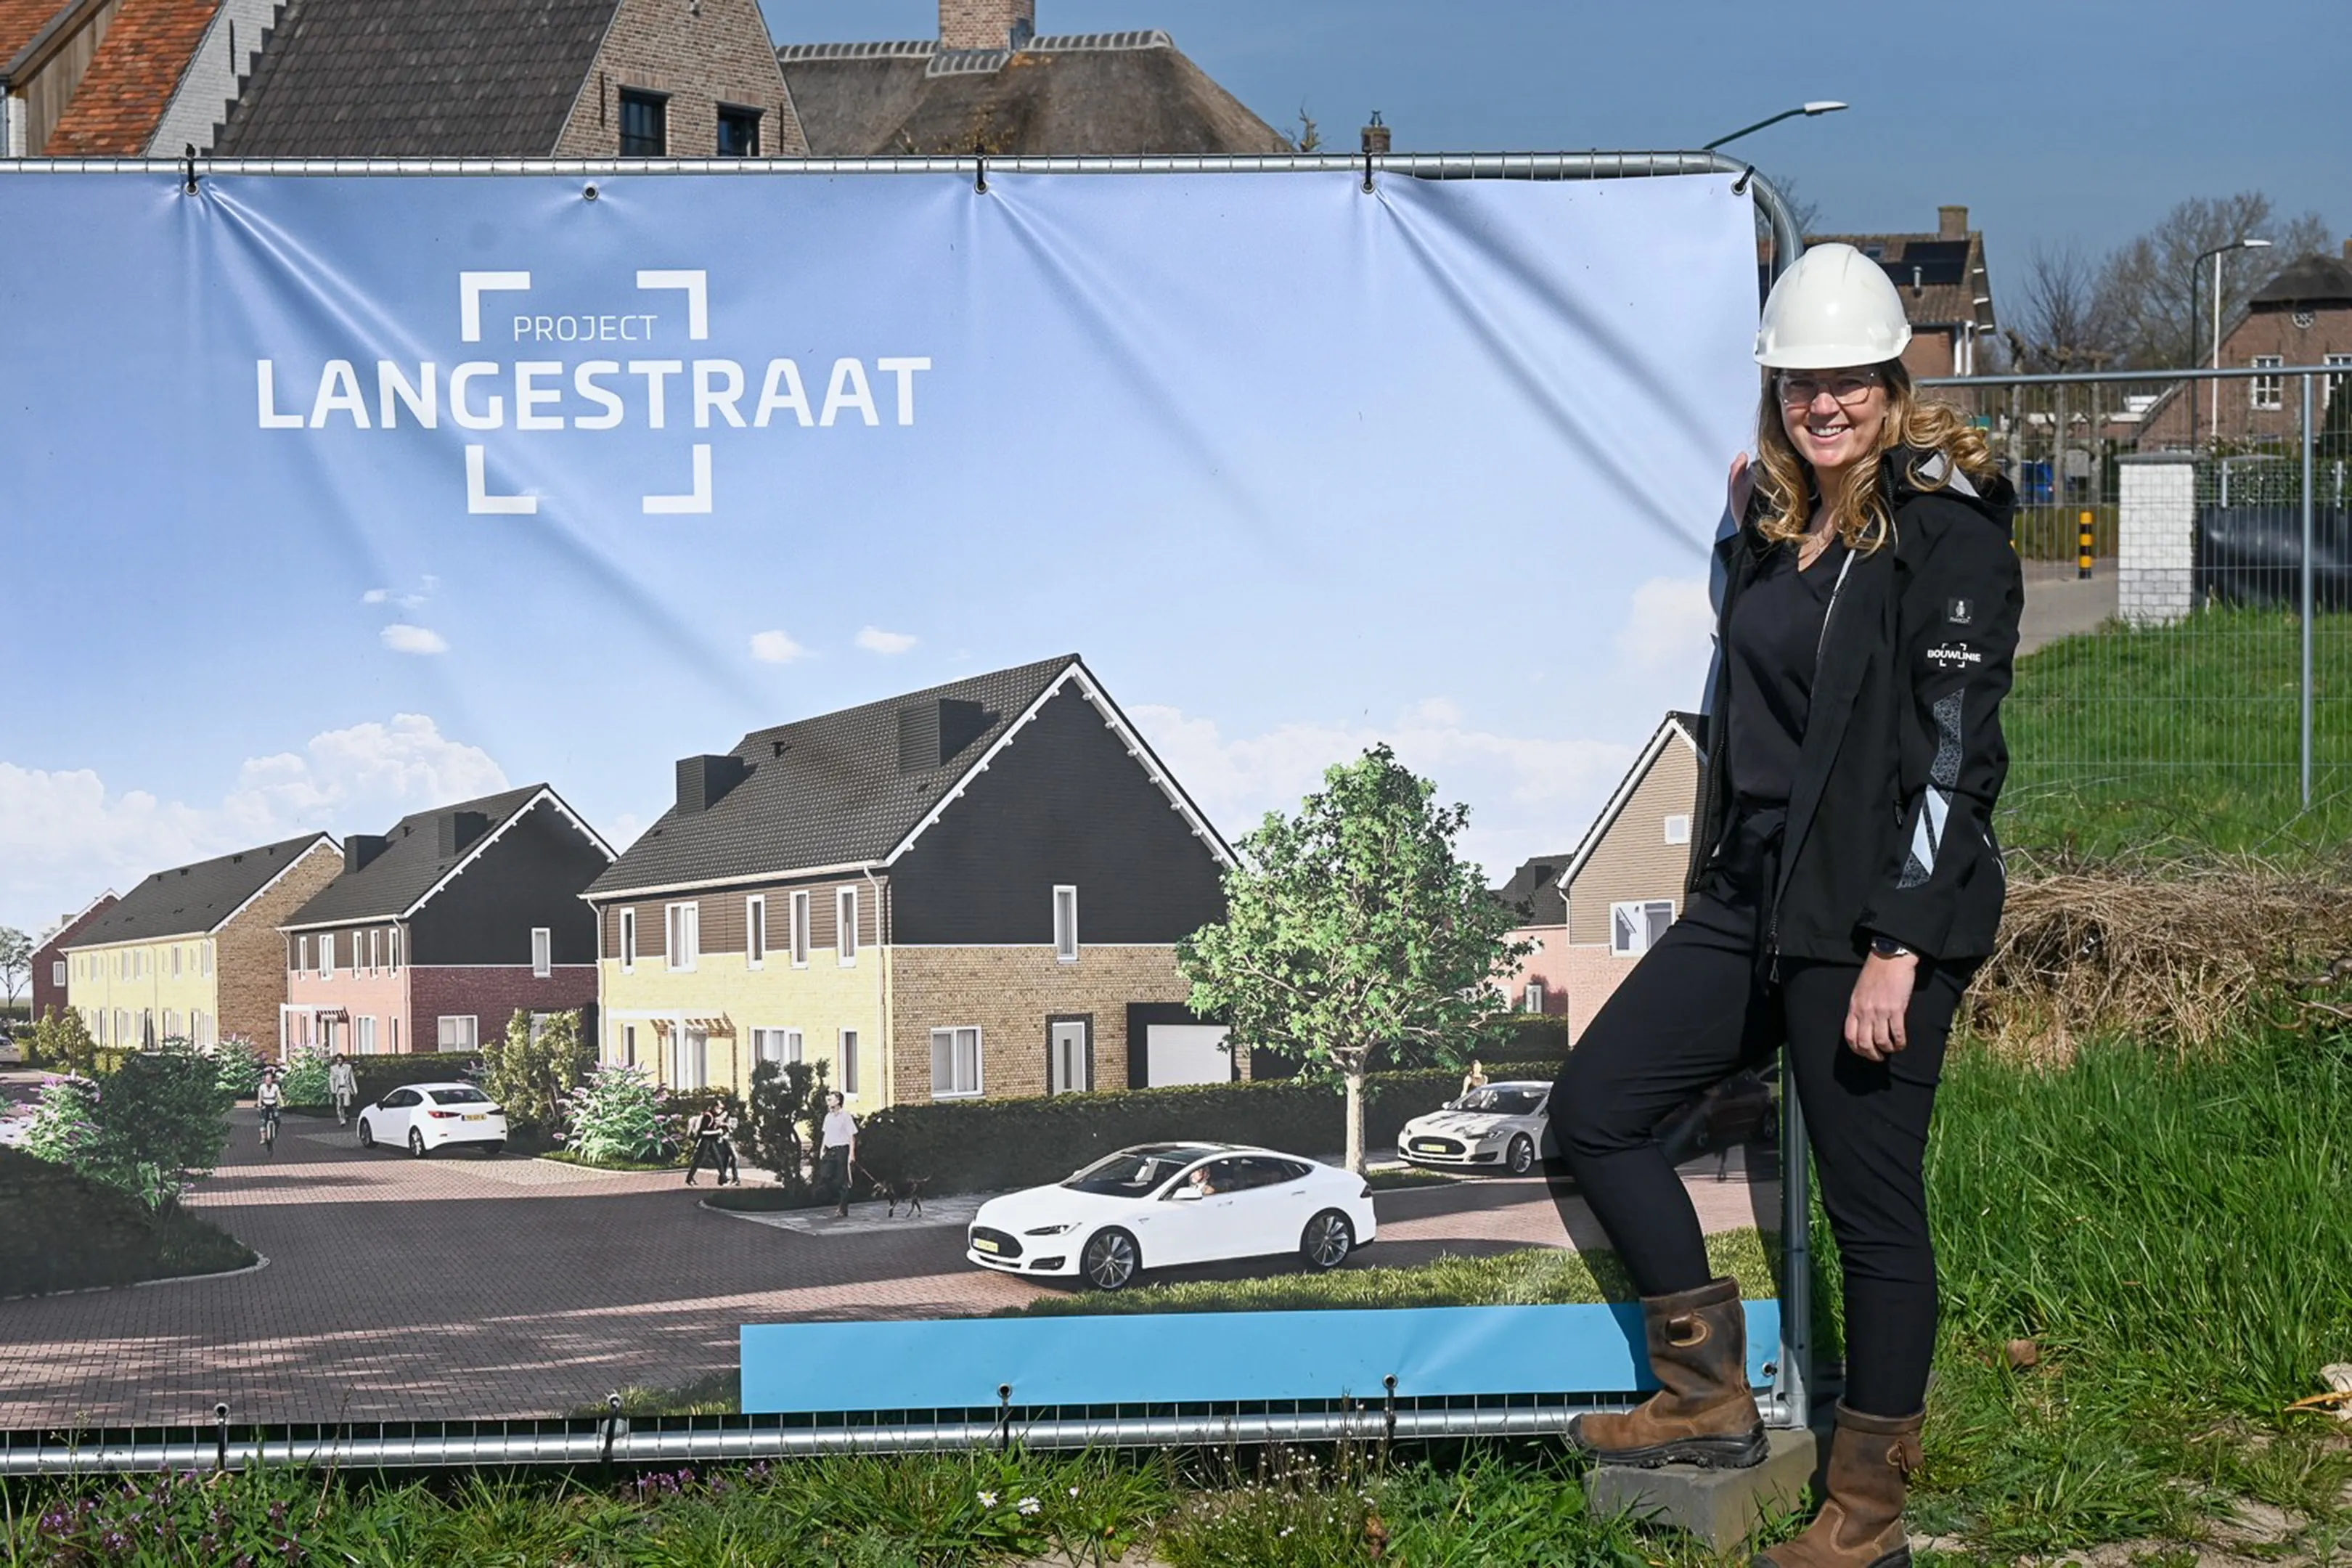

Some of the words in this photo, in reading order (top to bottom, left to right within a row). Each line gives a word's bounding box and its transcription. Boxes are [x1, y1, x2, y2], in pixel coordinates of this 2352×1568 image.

[513, 314, 658, 342] PROJECT
[256, 356, 932, 430] LANGESTRAAT
[1927, 650, 1981, 662] BOUWLINIE
